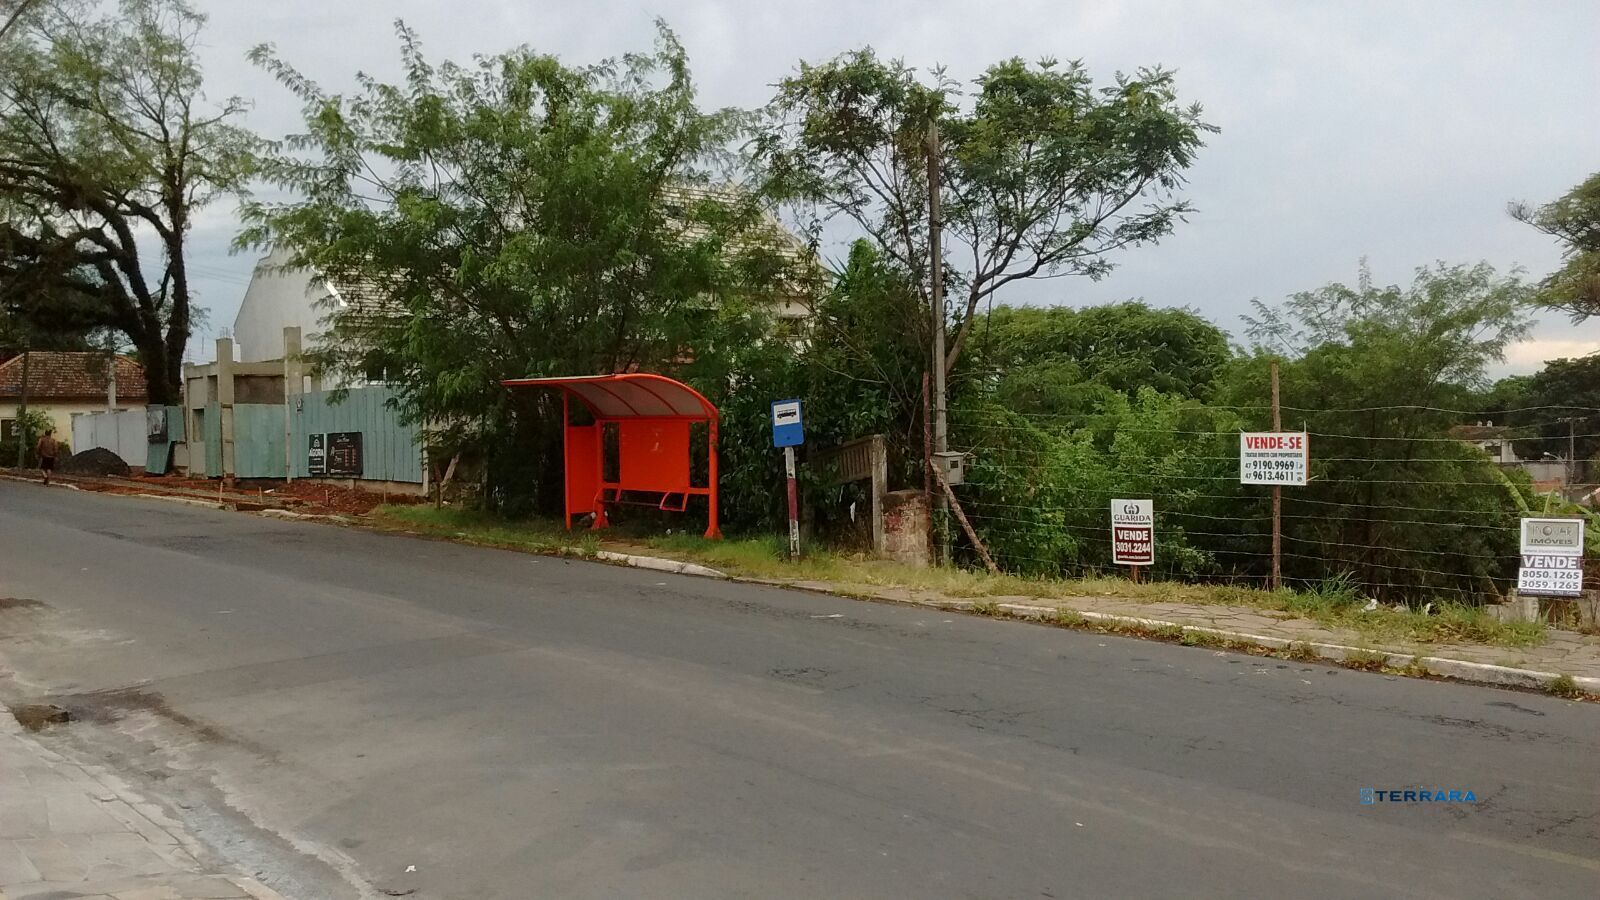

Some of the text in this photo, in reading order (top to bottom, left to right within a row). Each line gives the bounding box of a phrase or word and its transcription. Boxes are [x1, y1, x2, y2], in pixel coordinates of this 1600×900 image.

[1245, 436, 1302, 449] VENDE-SE
[1252, 460, 1295, 470] 9190.9969
[1252, 471, 1294, 481] 9613.4611
[1114, 514, 1151, 522] GUARIDA
[1117, 530, 1149, 541] VENDE
[1530, 537, 1573, 545] IMÓVEIS
[1116, 541, 1151, 553] 3031.2244
[1522, 555, 1578, 569] VENDE
[1521, 570, 1580, 580] 8050.1265
[1521, 580, 1579, 590] 3059.1265
